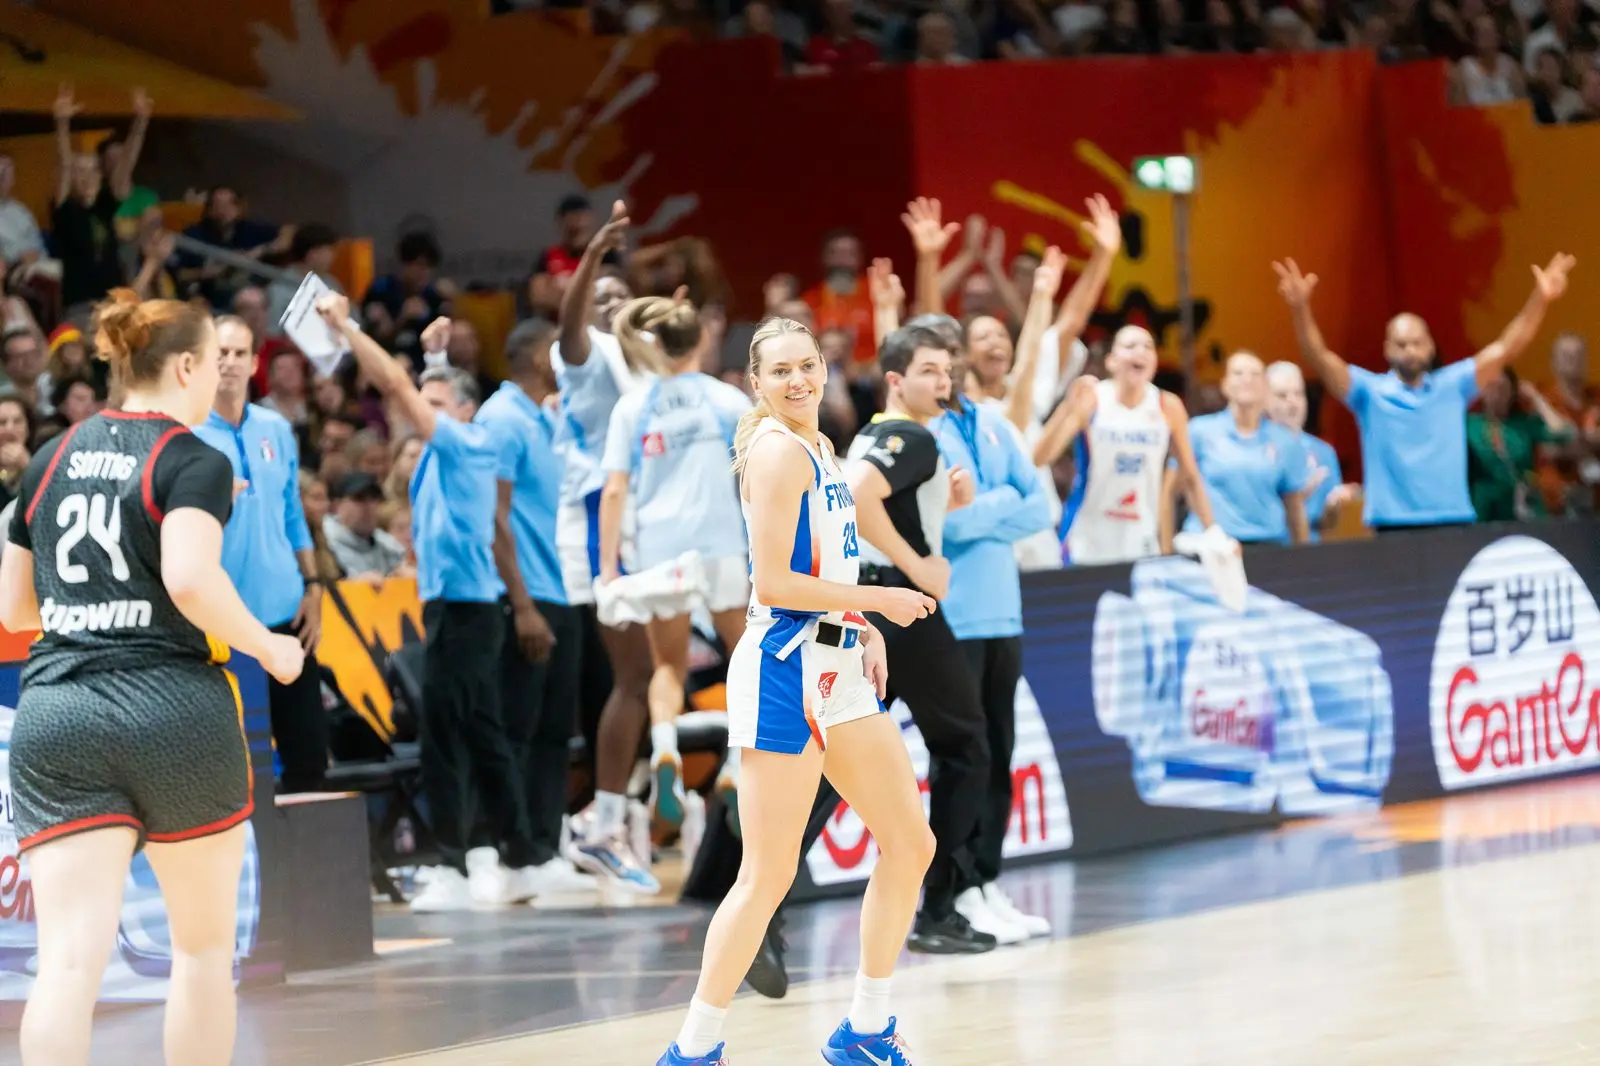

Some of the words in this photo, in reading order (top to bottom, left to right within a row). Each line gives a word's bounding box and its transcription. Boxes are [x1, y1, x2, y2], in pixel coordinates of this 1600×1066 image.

[56, 493, 131, 583] 24
[40, 597, 153, 636] tipwin
[1465, 575, 1574, 657] 百岁山
